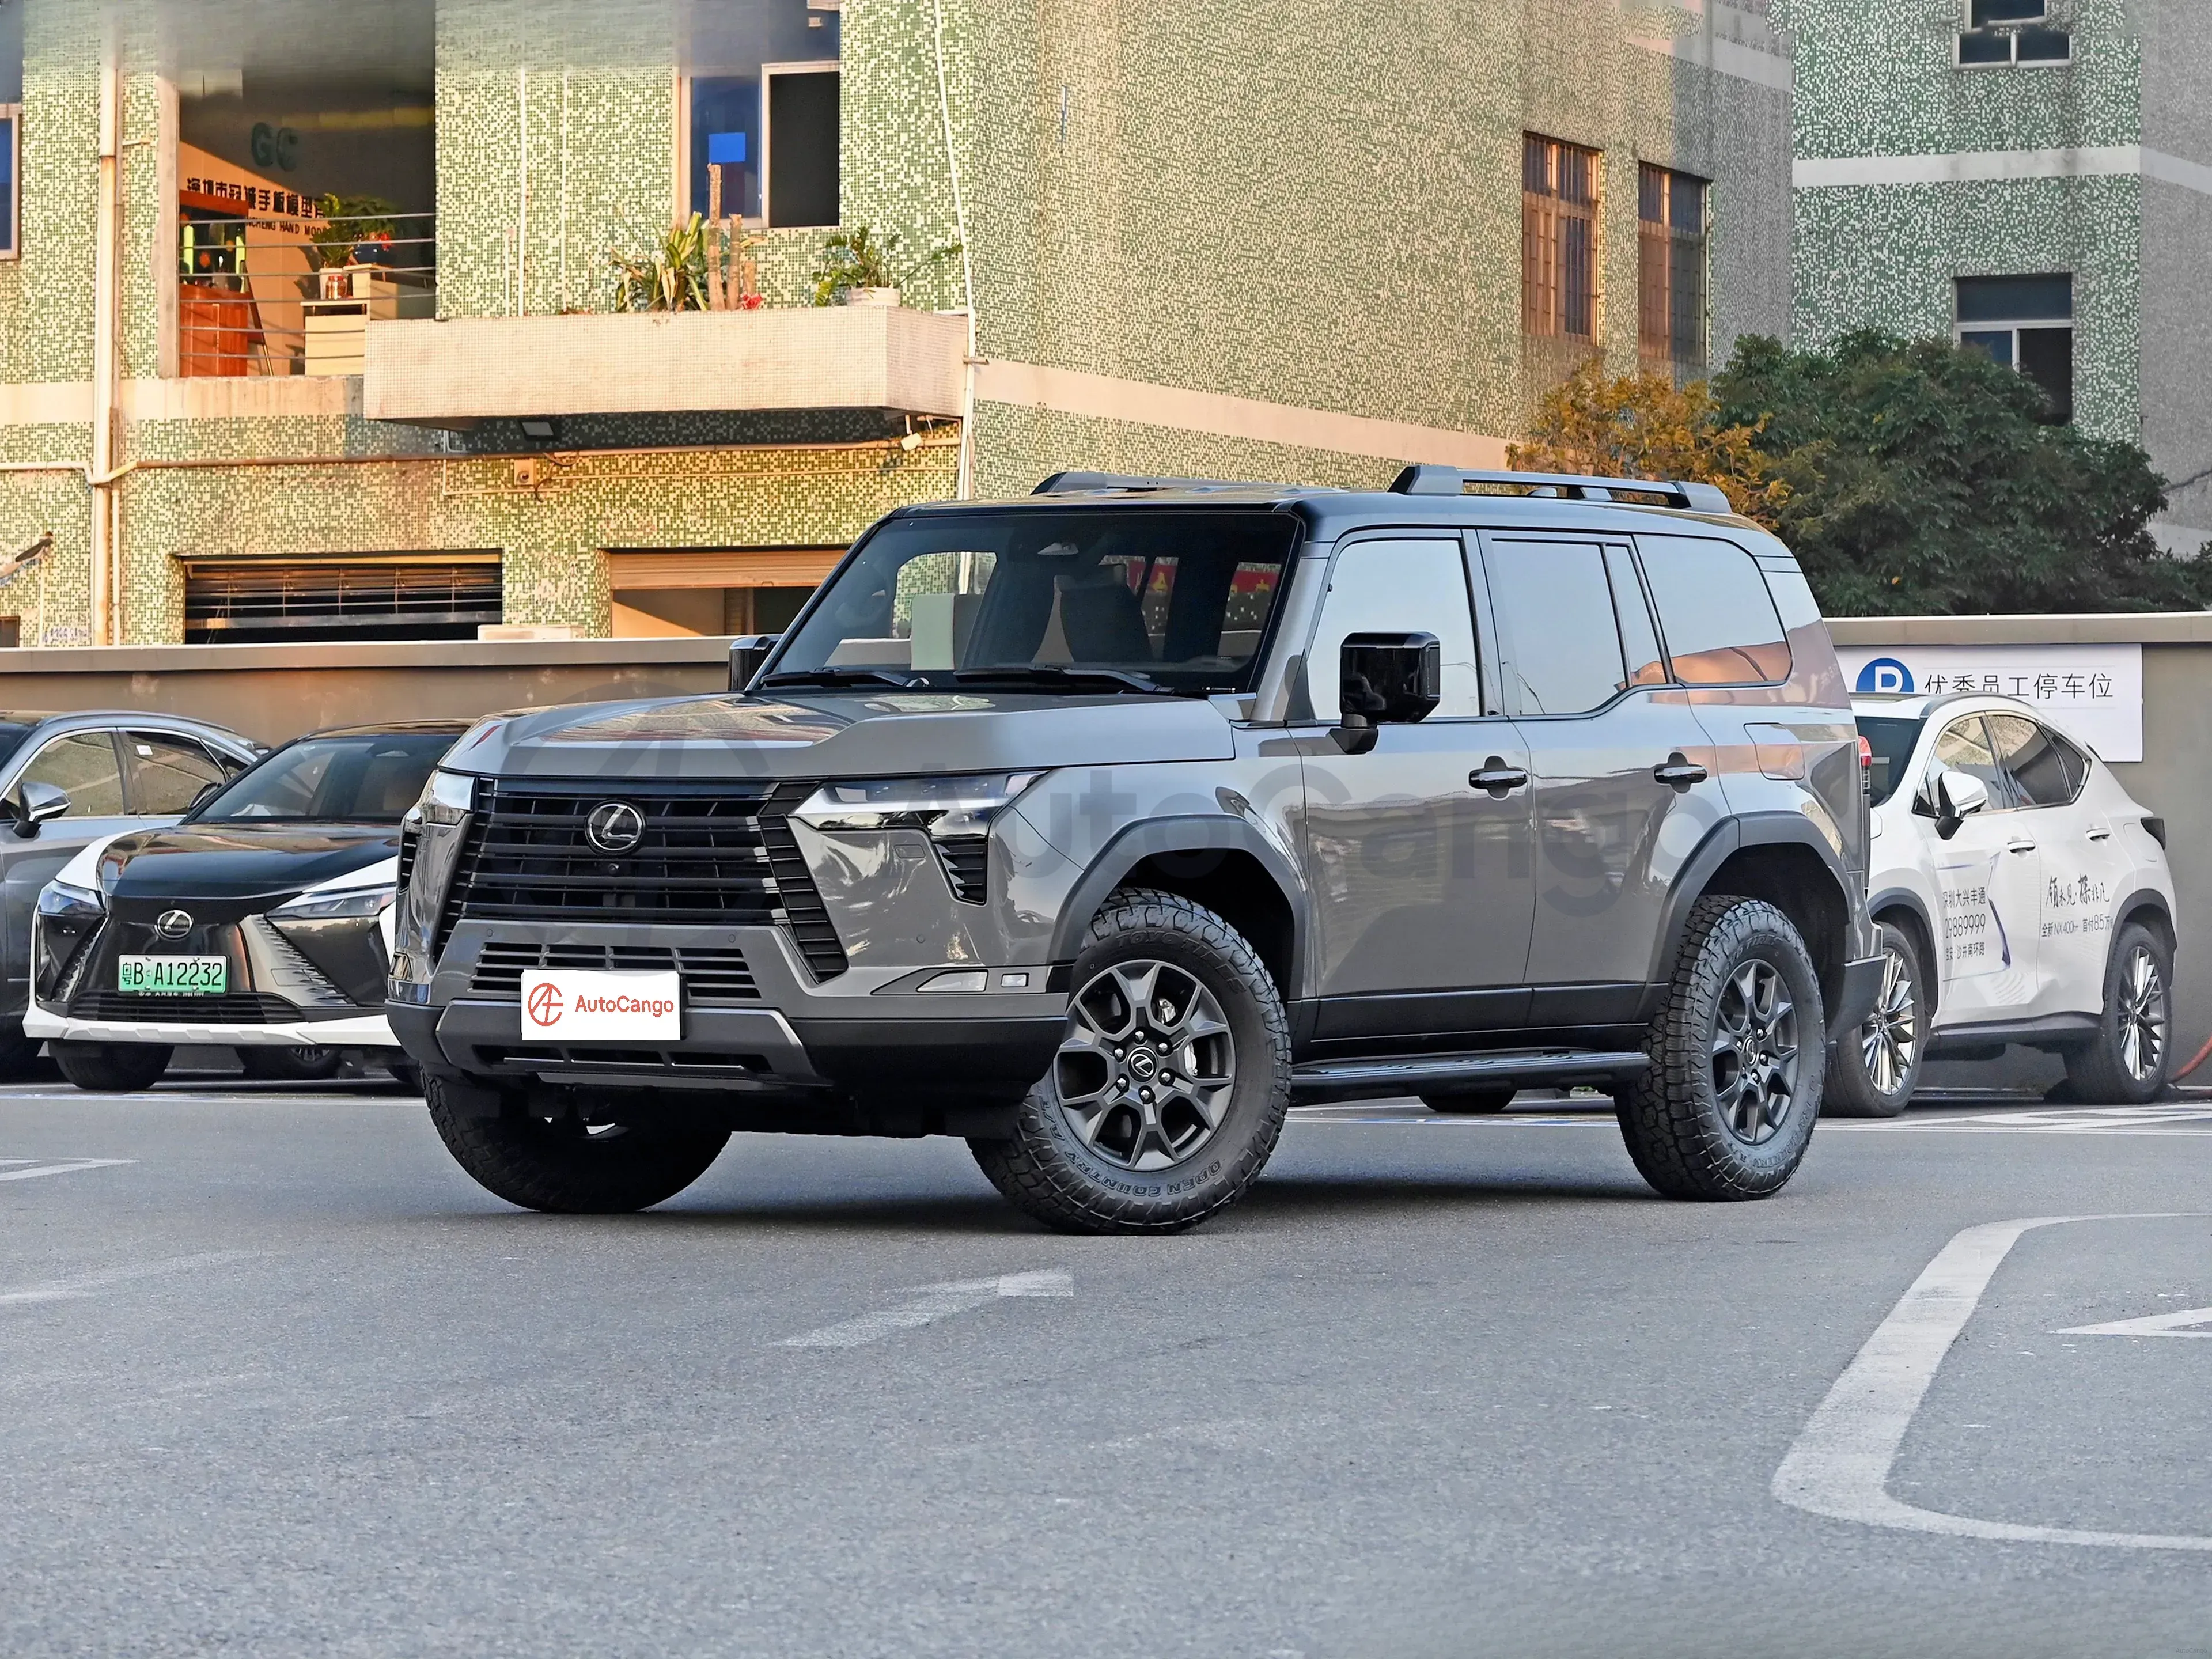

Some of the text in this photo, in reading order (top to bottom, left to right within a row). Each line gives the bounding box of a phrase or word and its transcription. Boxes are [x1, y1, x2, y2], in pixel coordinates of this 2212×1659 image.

[279, 221, 300, 235] HAND
[1925, 673, 2113, 699] 优秀员工停车位
[1116, 929, 1180, 948] TOYO
[154, 962, 222, 986] A12232
[1065, 1150, 1162, 1198] COUNTRY
[1166, 1158, 1223, 1196] OPEN
